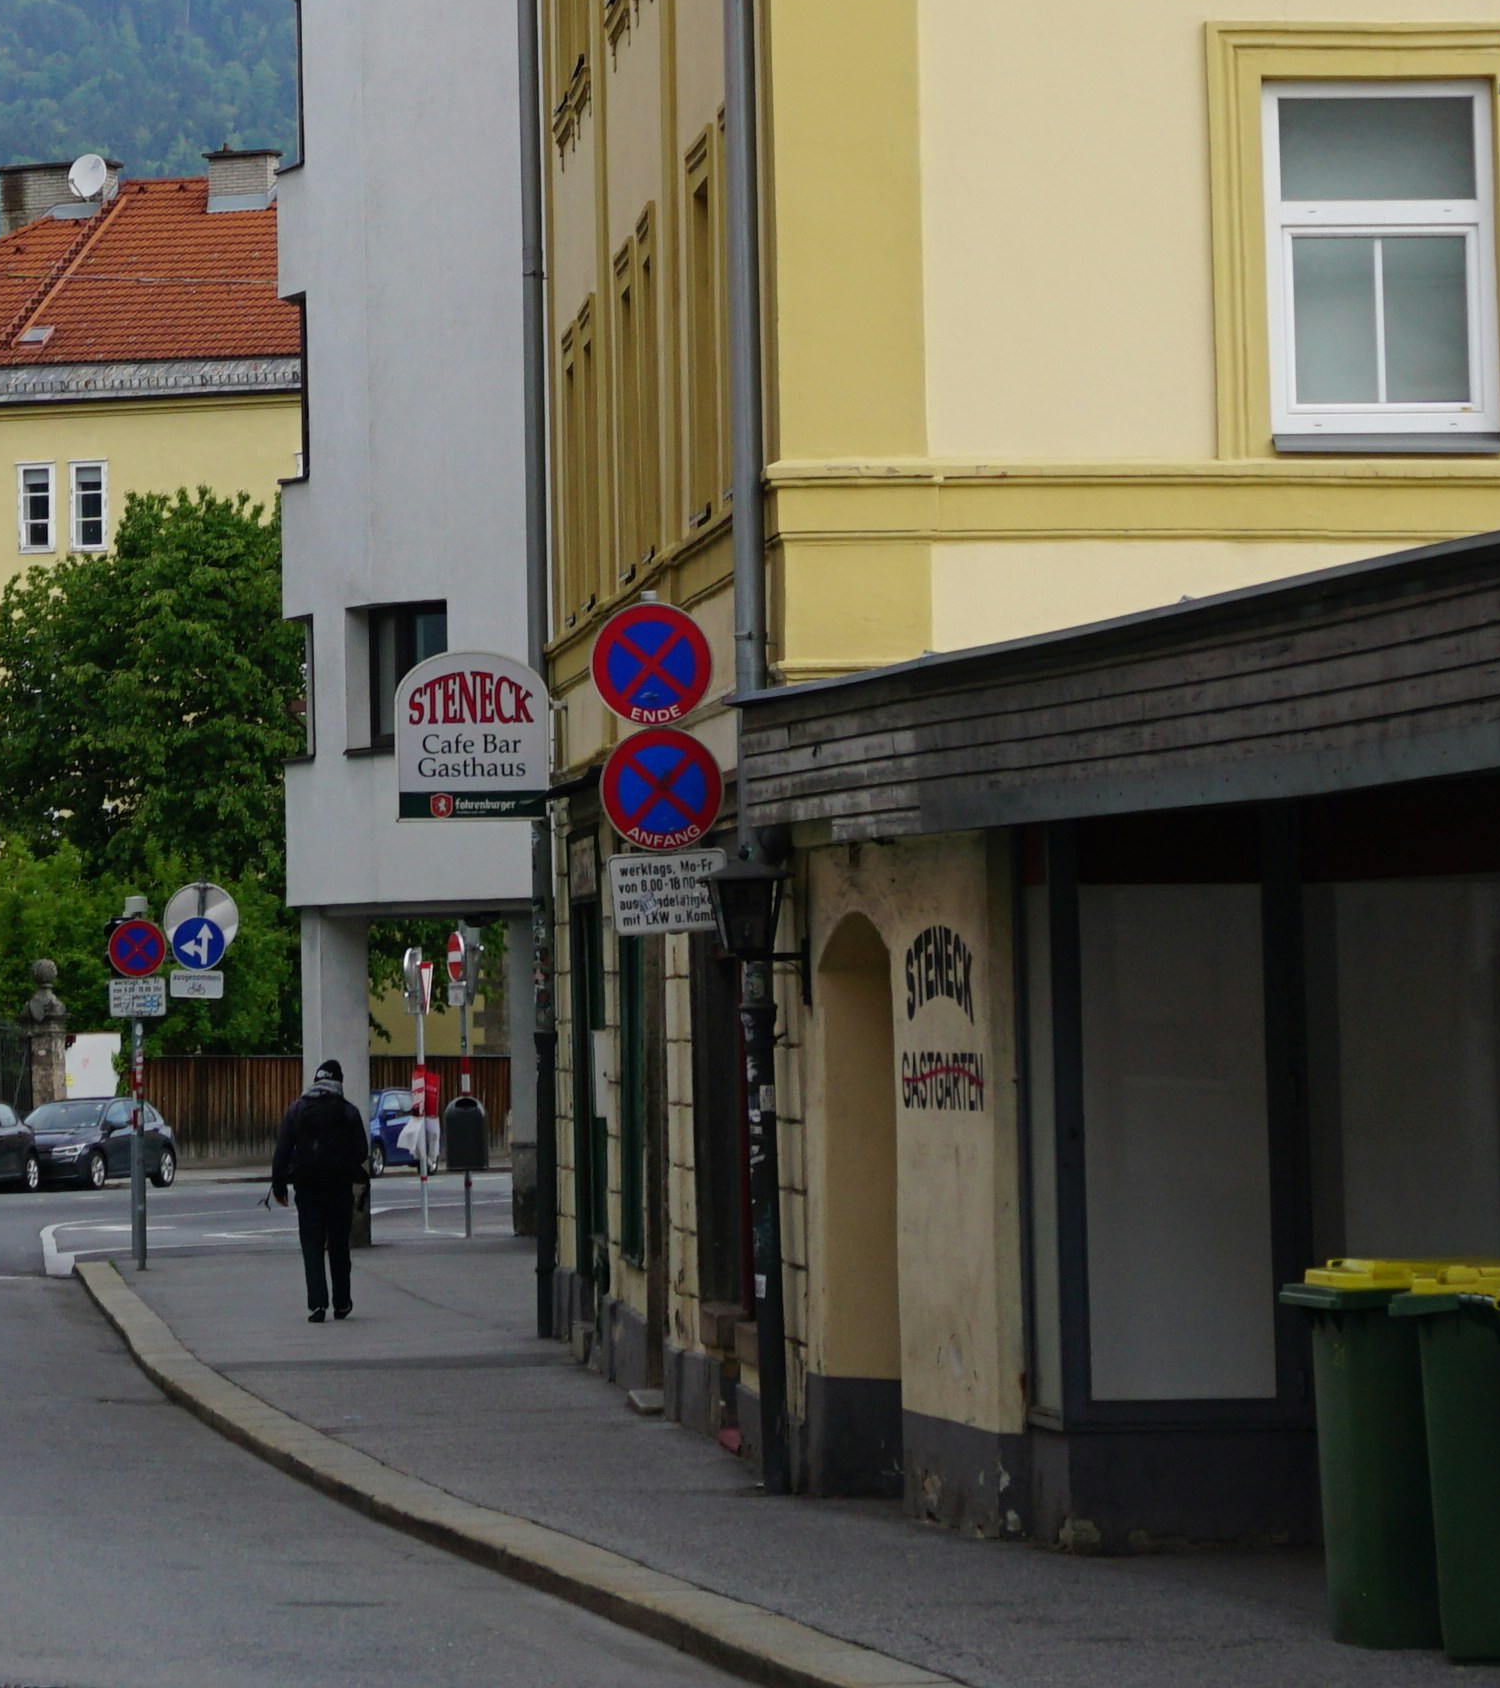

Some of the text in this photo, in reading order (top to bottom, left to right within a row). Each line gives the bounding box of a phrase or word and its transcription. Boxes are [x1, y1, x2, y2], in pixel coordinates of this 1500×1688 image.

[408, 670, 534, 725] STENECK
[630, 704, 682, 723] ENDE
[422, 733, 522, 754] Cafe Bar
[418, 757, 526, 778] Gasthaus
[627, 824, 700, 848] ANFANG
[680, 859, 713, 872] Mo-Fr
[618, 883, 638, 894] von
[623, 913, 640, 927] mit
[646, 911, 670, 925] LKW
[905, 925, 974, 1026] STENECK
[903, 1051, 984, 1112] GASTGARTEN
